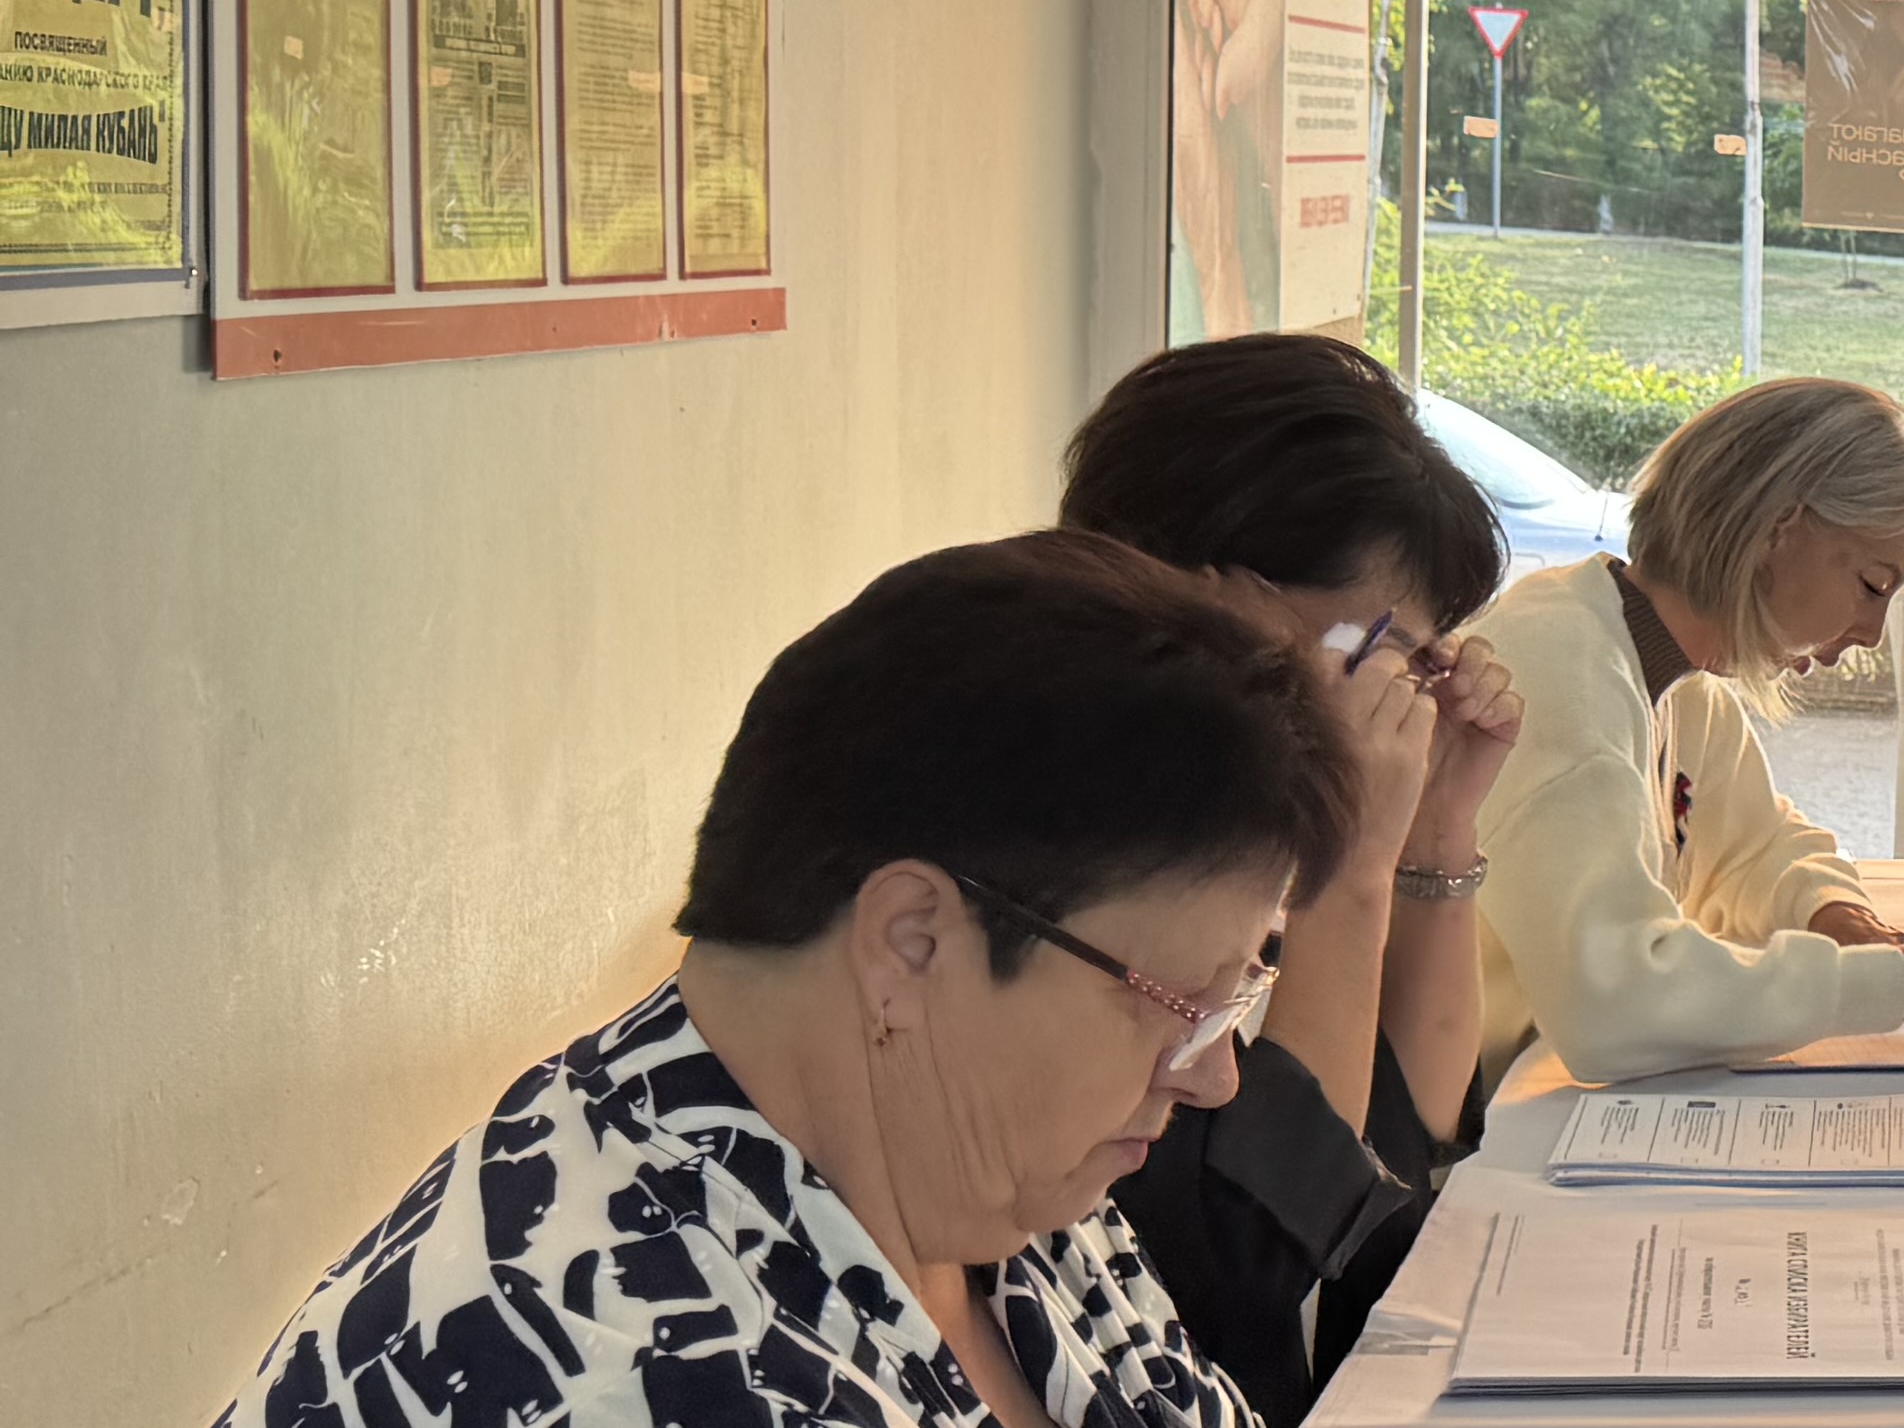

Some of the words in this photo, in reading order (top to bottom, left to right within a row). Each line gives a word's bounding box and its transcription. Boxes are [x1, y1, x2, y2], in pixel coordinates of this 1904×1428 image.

[27, 110, 92, 151] МИЛАЯ
[1785, 1231, 1810, 1257] КНИГА
[1785, 1259, 1810, 1293] СПИСКА
[1785, 1295, 1817, 1360] ИЗБИРАТЕЛЕЙ
